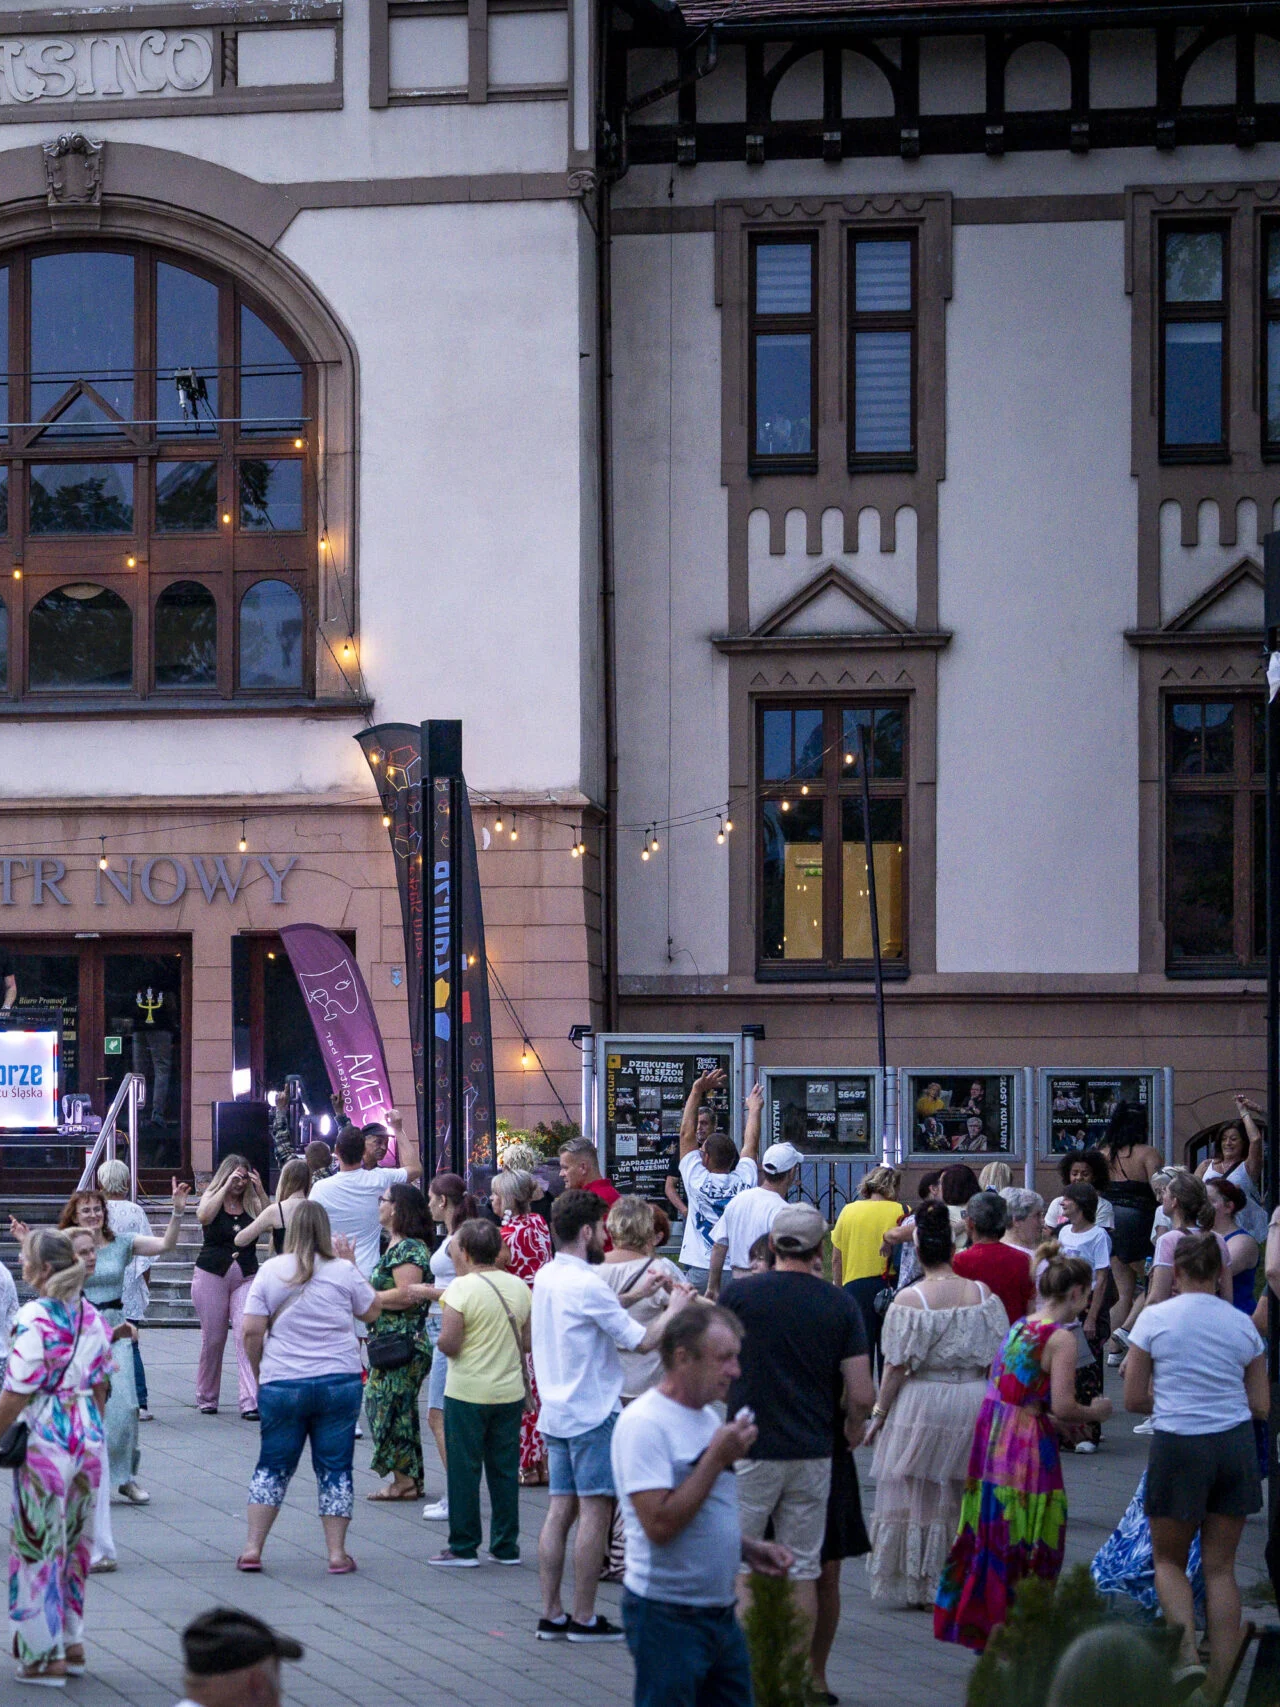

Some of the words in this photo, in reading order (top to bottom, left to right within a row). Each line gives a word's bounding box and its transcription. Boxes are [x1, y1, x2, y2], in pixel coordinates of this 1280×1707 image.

[94, 855, 299, 906] NOWY
[11, 1086, 43, 1099] Śląska
[639, 1075, 684, 1083] 2025/2026
[808, 1084, 830, 1093] 276
[607, 1069, 617, 1122] repertuar
[772, 1100, 780, 1143] ATYSTYKI
[1000, 1107, 1008, 1149] KULTURY
[620, 1158, 670, 1167] ZAPRASZAMY
